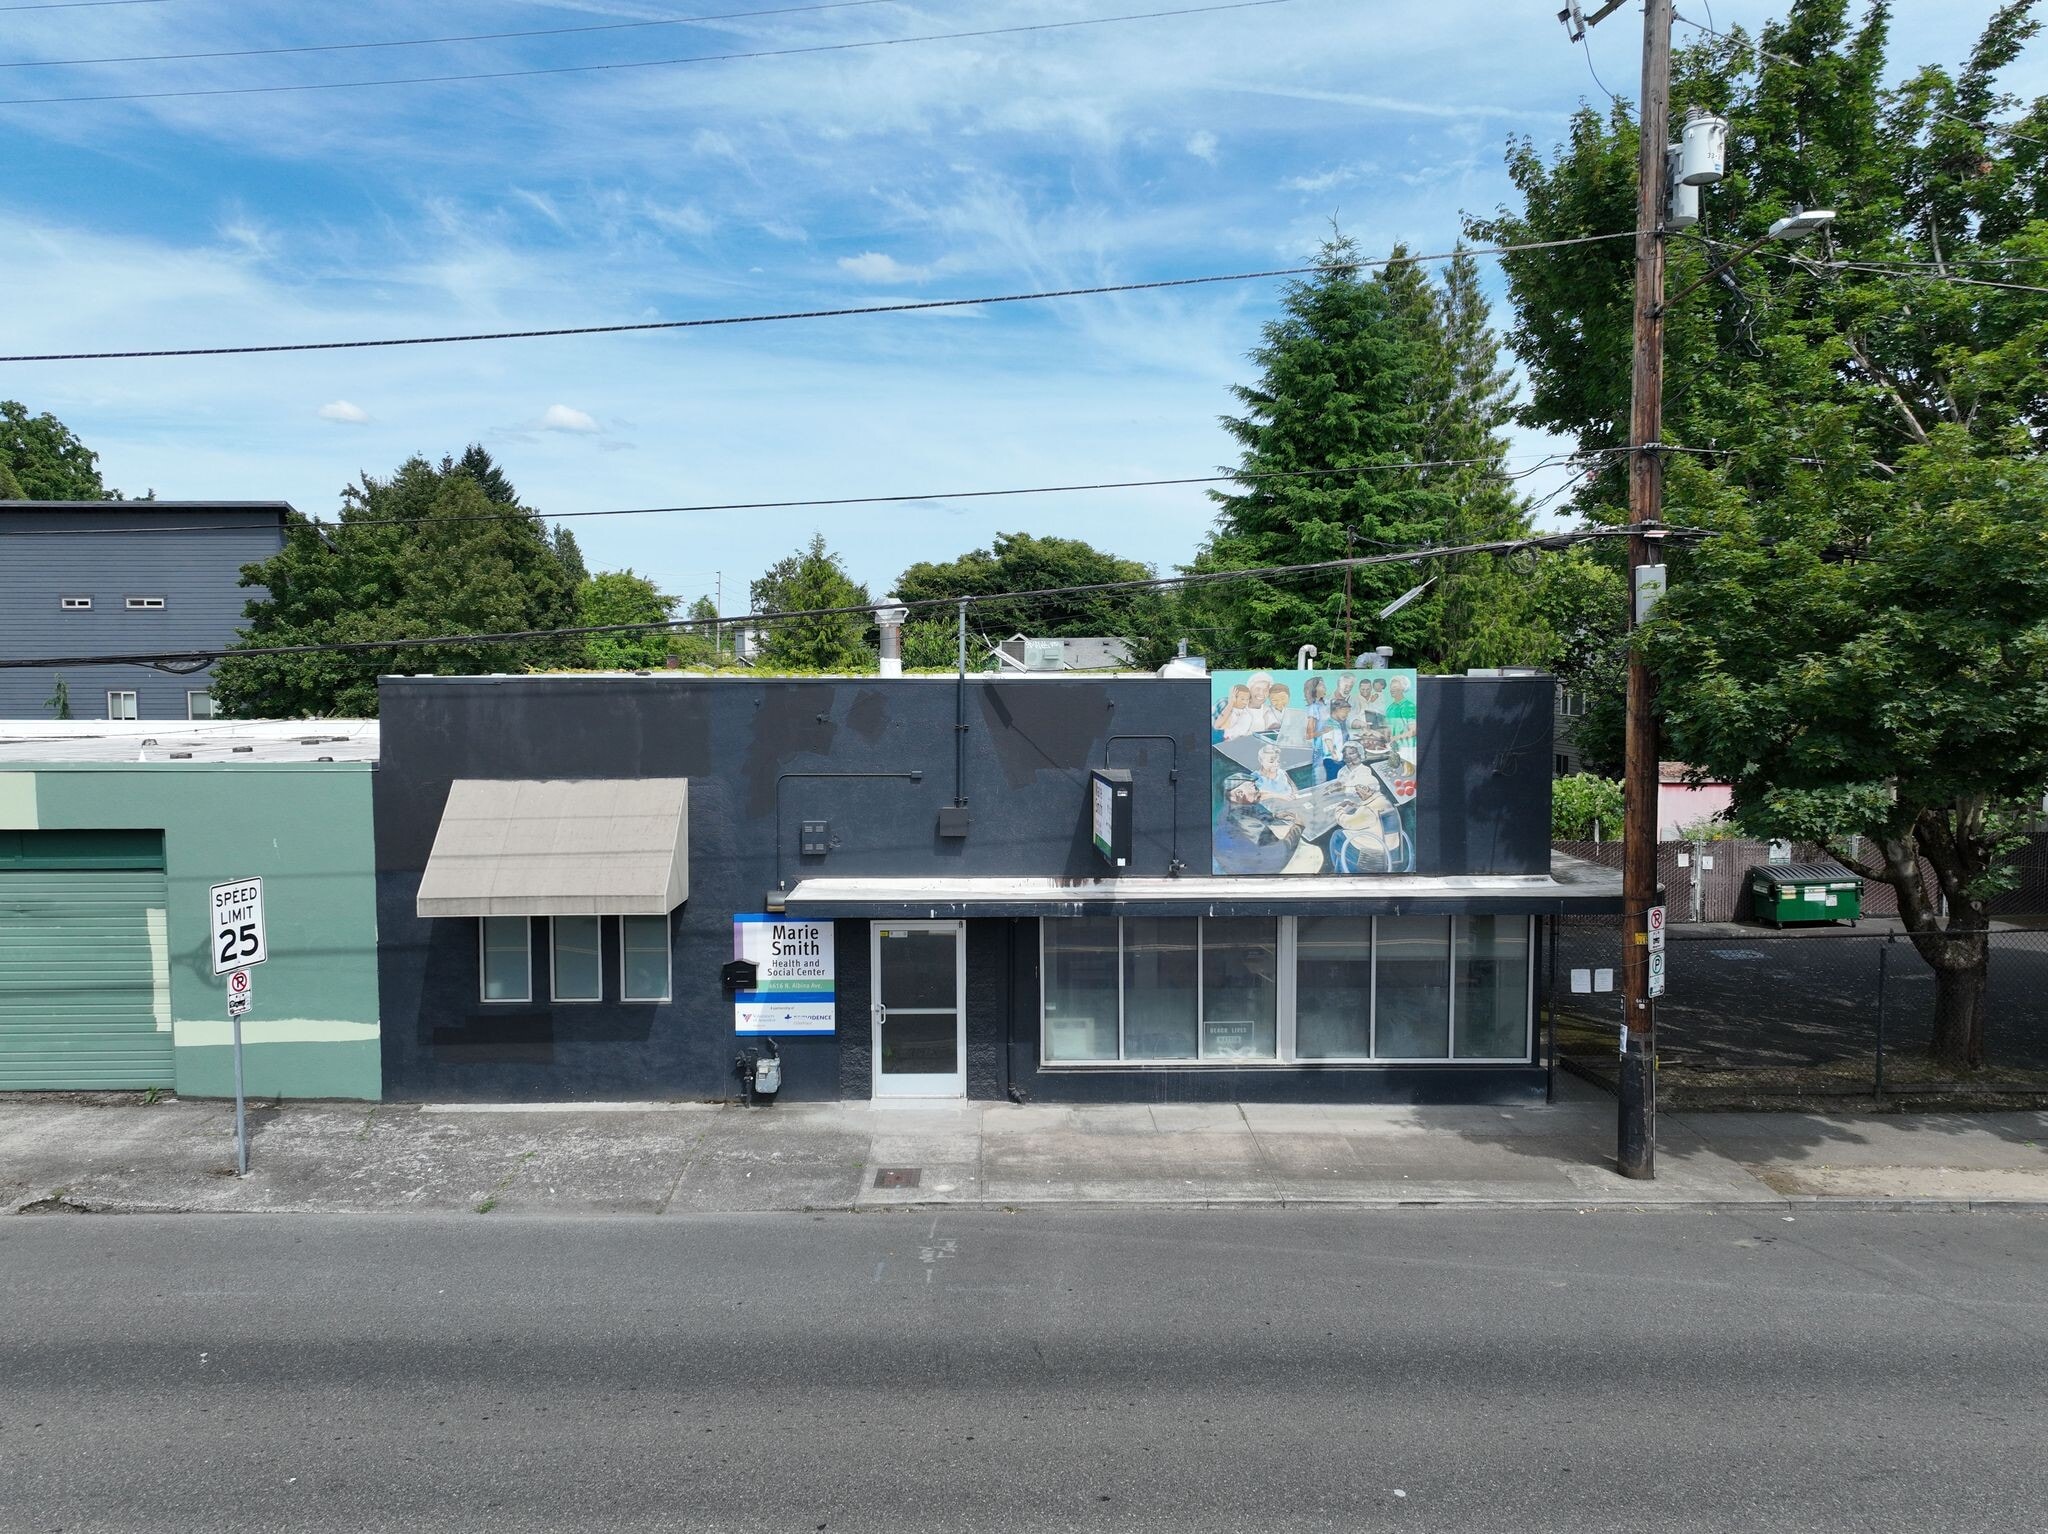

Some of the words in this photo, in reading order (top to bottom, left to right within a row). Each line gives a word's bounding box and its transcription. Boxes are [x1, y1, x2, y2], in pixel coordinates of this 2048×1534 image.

[216, 887, 258, 908] SPEED
[220, 905, 254, 925] LIMIT
[773, 924, 819, 940] Marie
[219, 923, 259, 964] 25
[772, 940, 820, 956] Smith
[772, 959, 801, 968] Health
[803, 959, 820, 968] and
[767, 968, 794, 976] Social
[796, 968, 825, 976] Center
